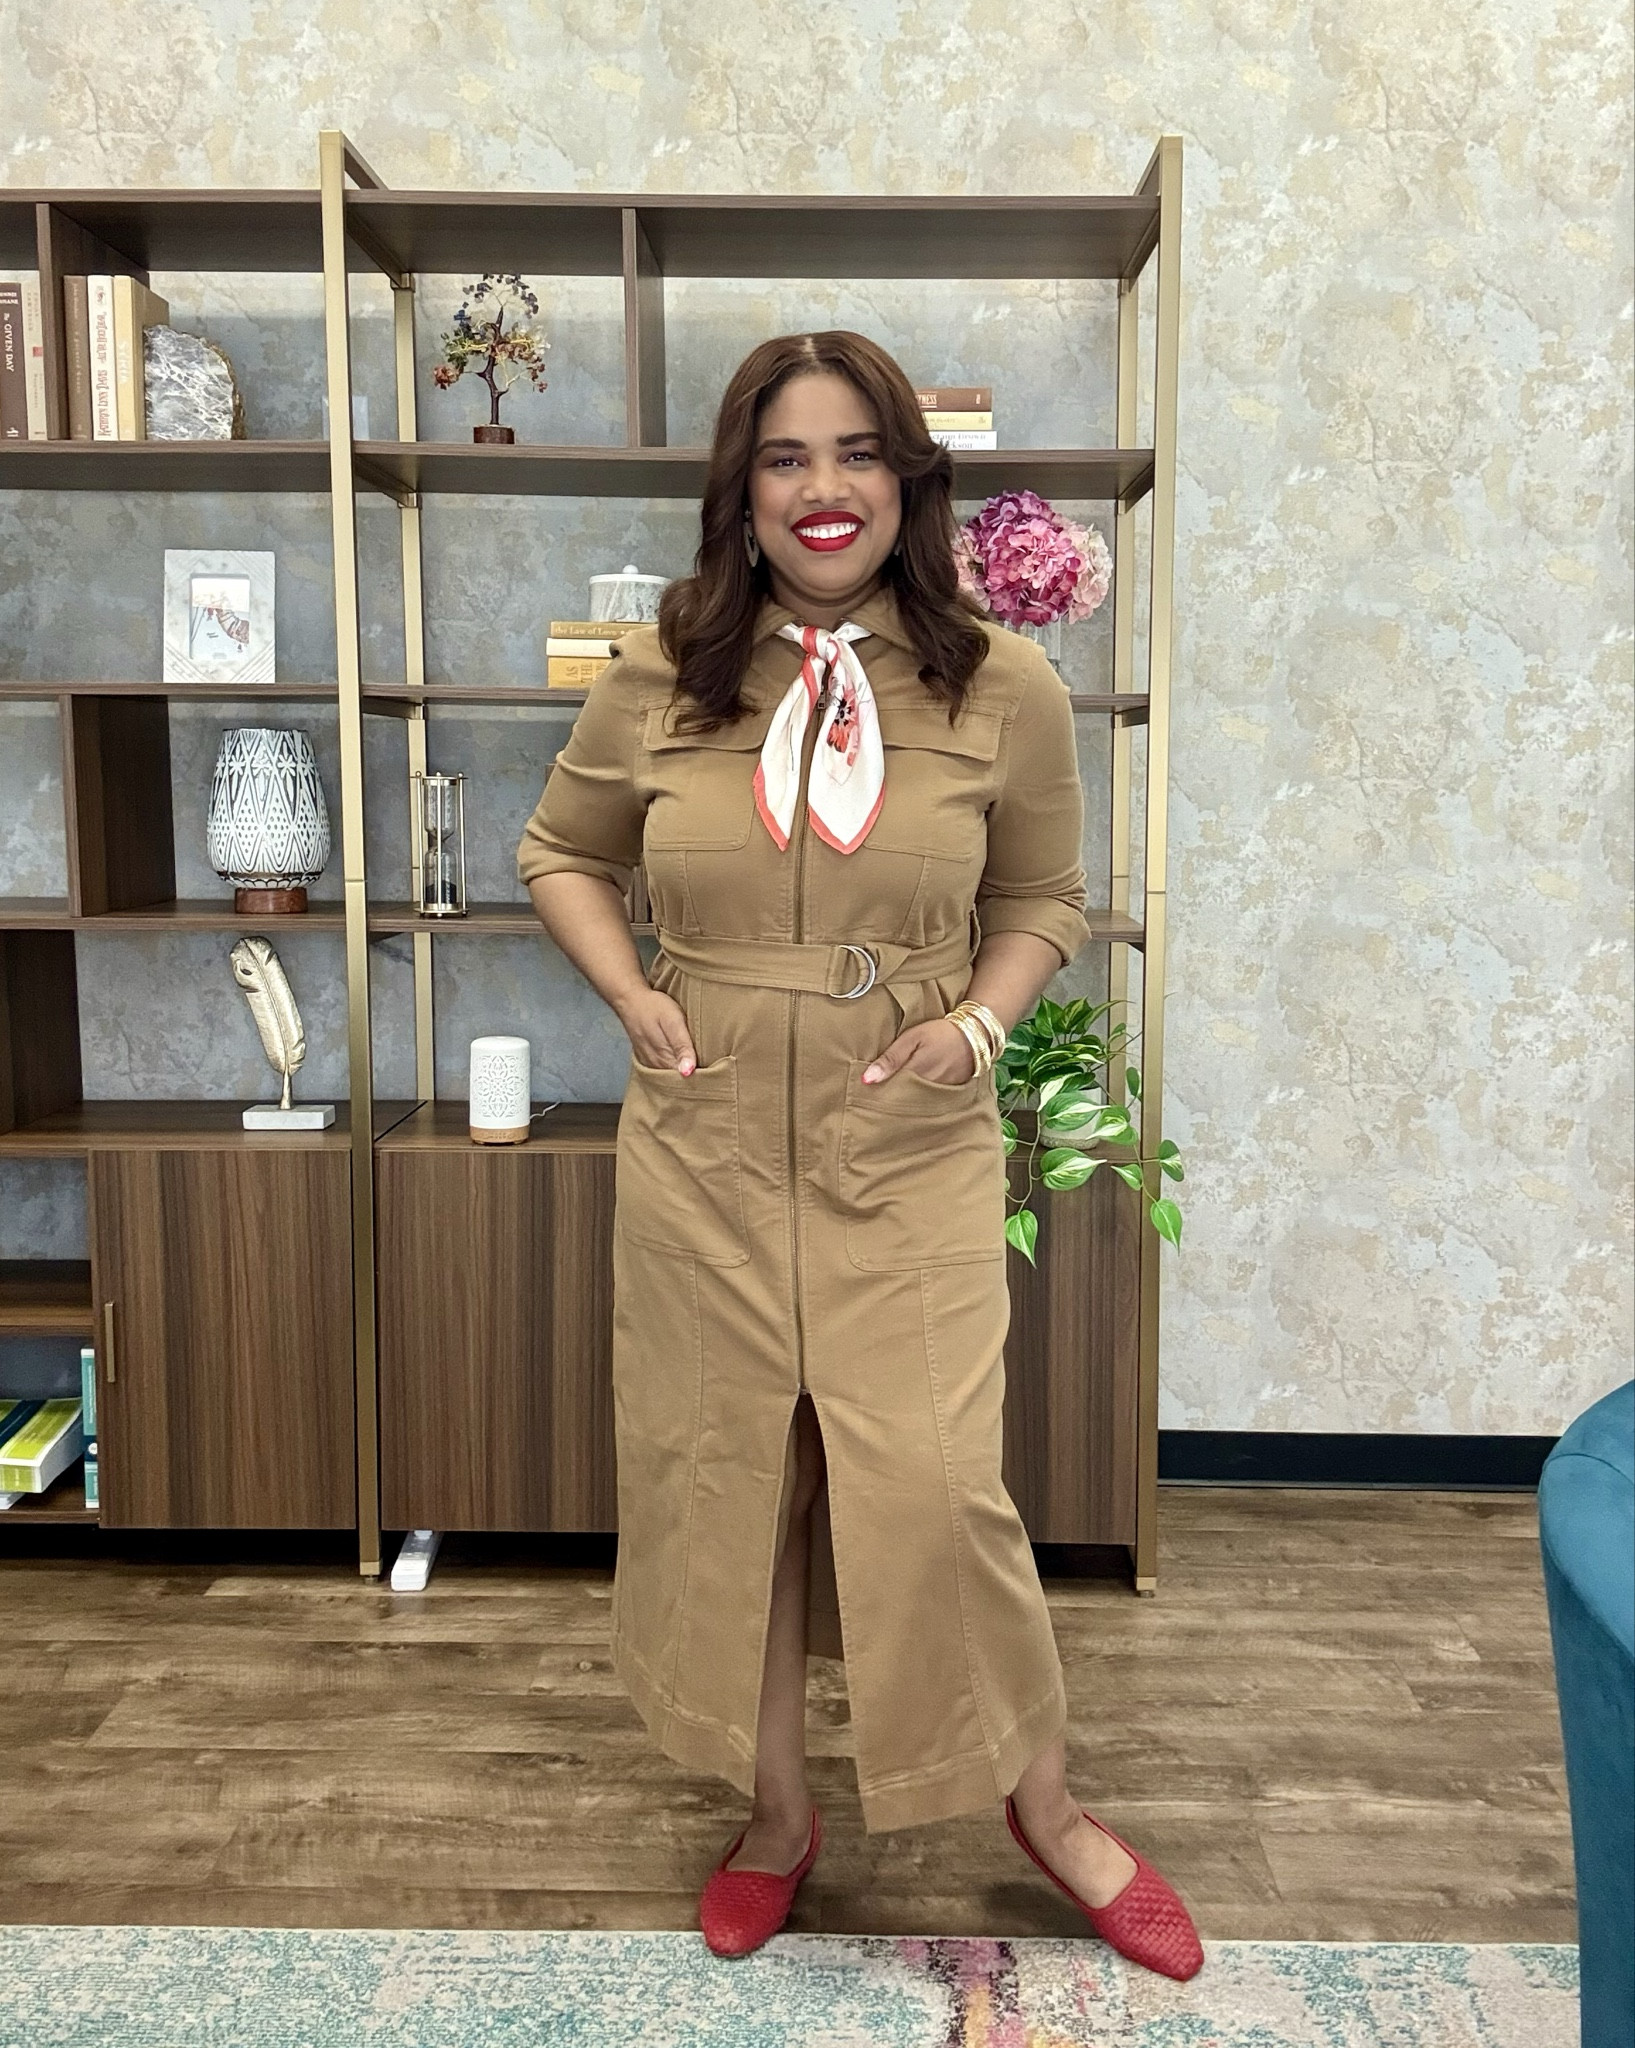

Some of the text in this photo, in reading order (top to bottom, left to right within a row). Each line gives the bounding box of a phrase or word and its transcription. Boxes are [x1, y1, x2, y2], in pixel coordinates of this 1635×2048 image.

[4, 323, 13, 352] GIVEN
[6, 353, 15, 372] DAY
[566, 666, 579, 679] AS
[580, 663, 593, 684] THE
